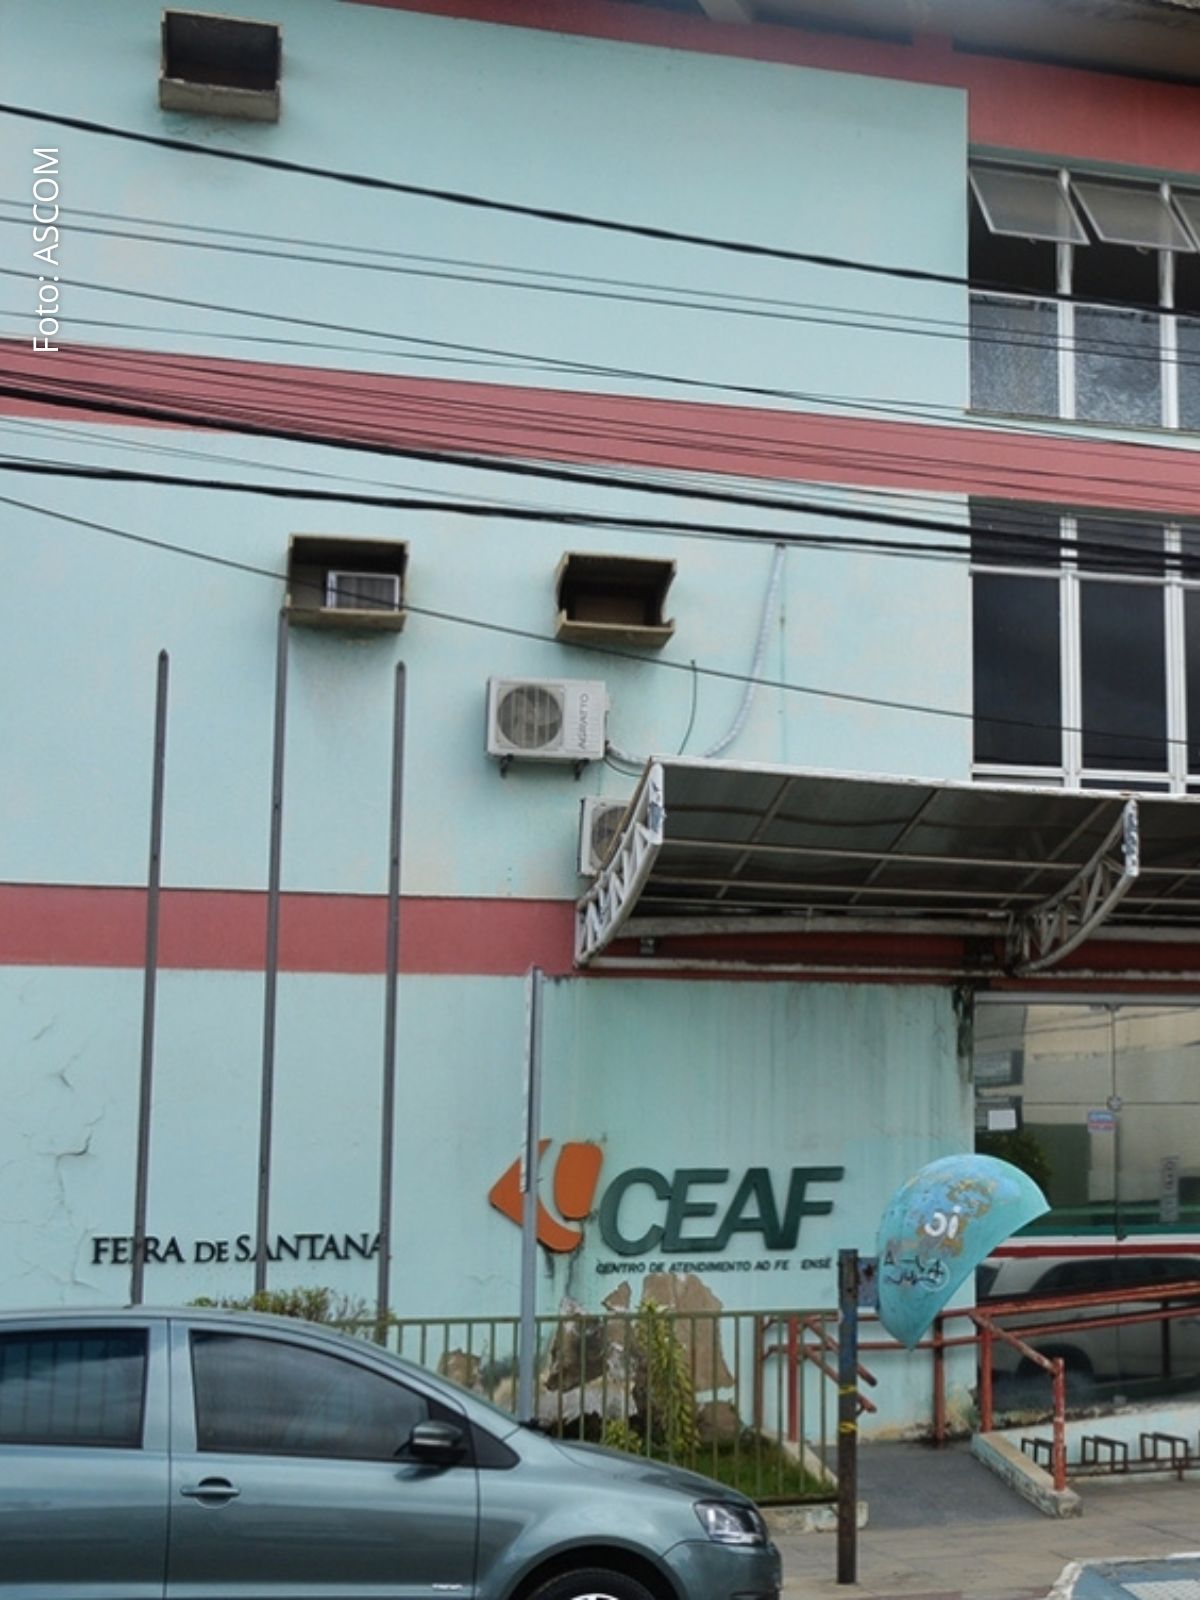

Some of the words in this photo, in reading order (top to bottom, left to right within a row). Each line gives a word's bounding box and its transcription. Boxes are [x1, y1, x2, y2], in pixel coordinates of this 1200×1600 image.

[600, 1166, 845, 1257] CEAF
[194, 1241, 229, 1263] DE
[596, 1261, 646, 1274] CENTRO
[649, 1262, 664, 1273] DE
[668, 1260, 751, 1273] ATENDIMENTO
[754, 1260, 771, 1272] AO
